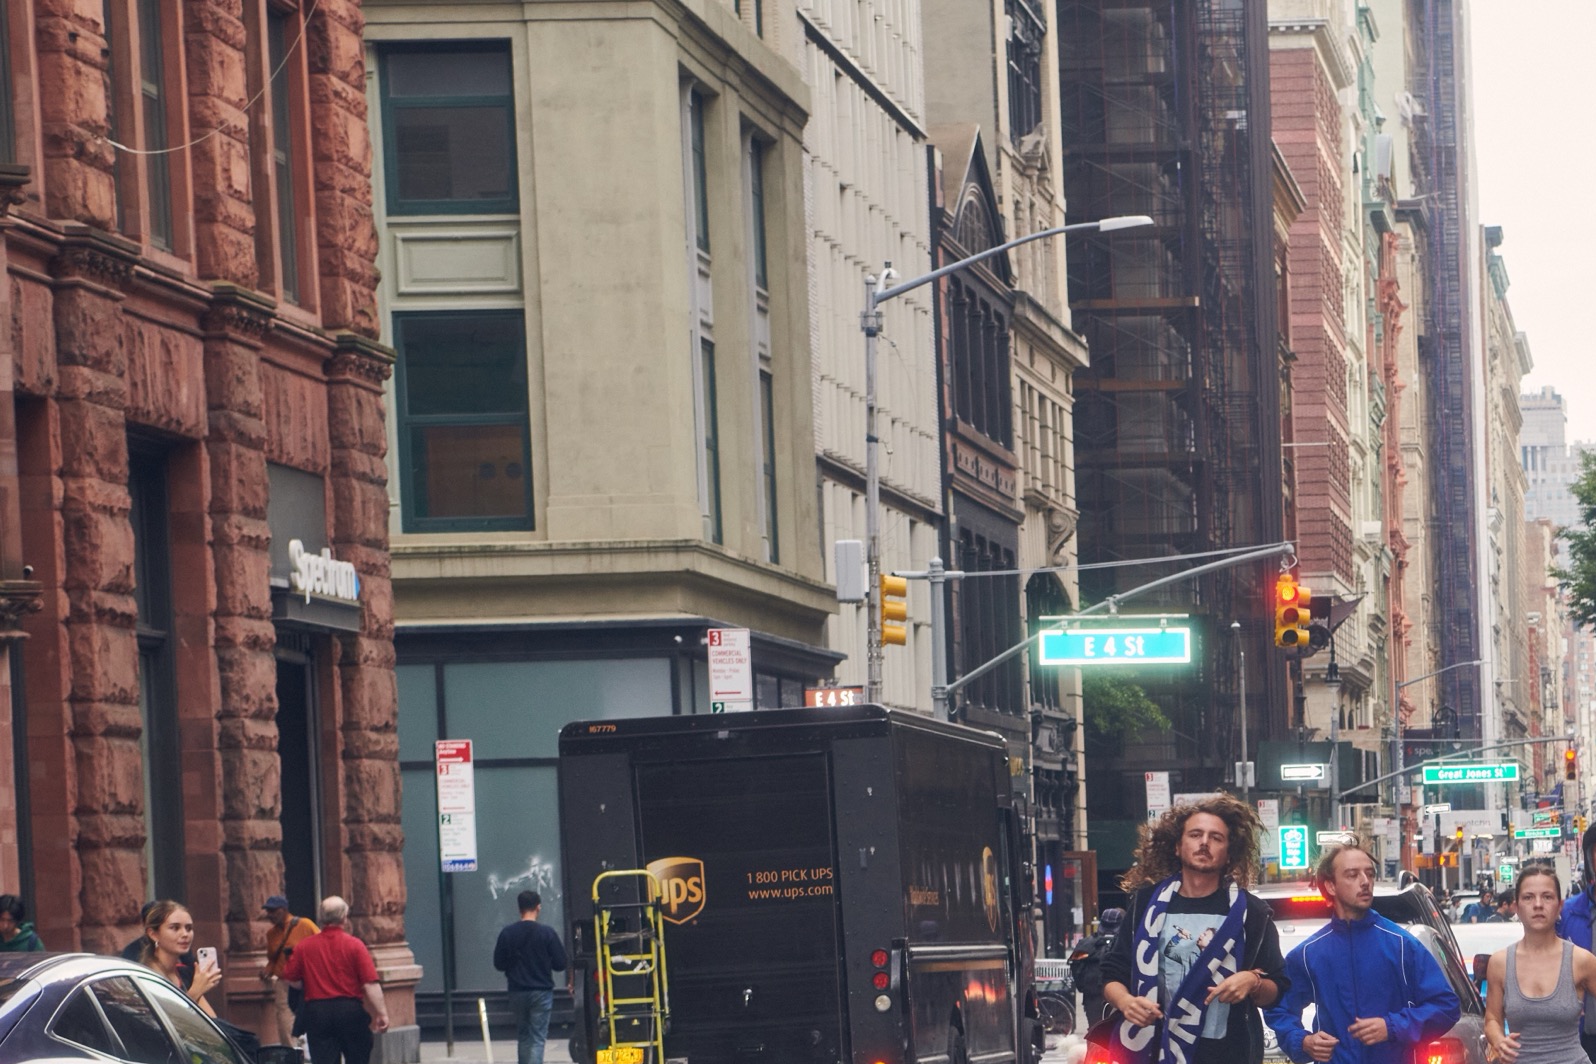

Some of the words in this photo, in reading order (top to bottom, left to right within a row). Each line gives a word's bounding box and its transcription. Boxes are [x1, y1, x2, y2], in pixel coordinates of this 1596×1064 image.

[711, 631, 721, 646] 3
[1084, 636, 1096, 657] E
[1103, 636, 1117, 657] 4
[1124, 635, 1145, 657] St
[815, 691, 824, 707] E
[827, 691, 837, 707] 4
[840, 690, 855, 706] St
[1437, 769, 1463, 780] Great
[1465, 768, 1492, 780] Jones
[1494, 768, 1504, 778] St
[746, 872, 752, 884] 1
[755, 870, 778, 884] 800
[781, 868, 808, 882] PICK
[811, 866, 834, 880] UPS
[660, 876, 703, 915] ups
[748, 884, 834, 900] www.ups.com
